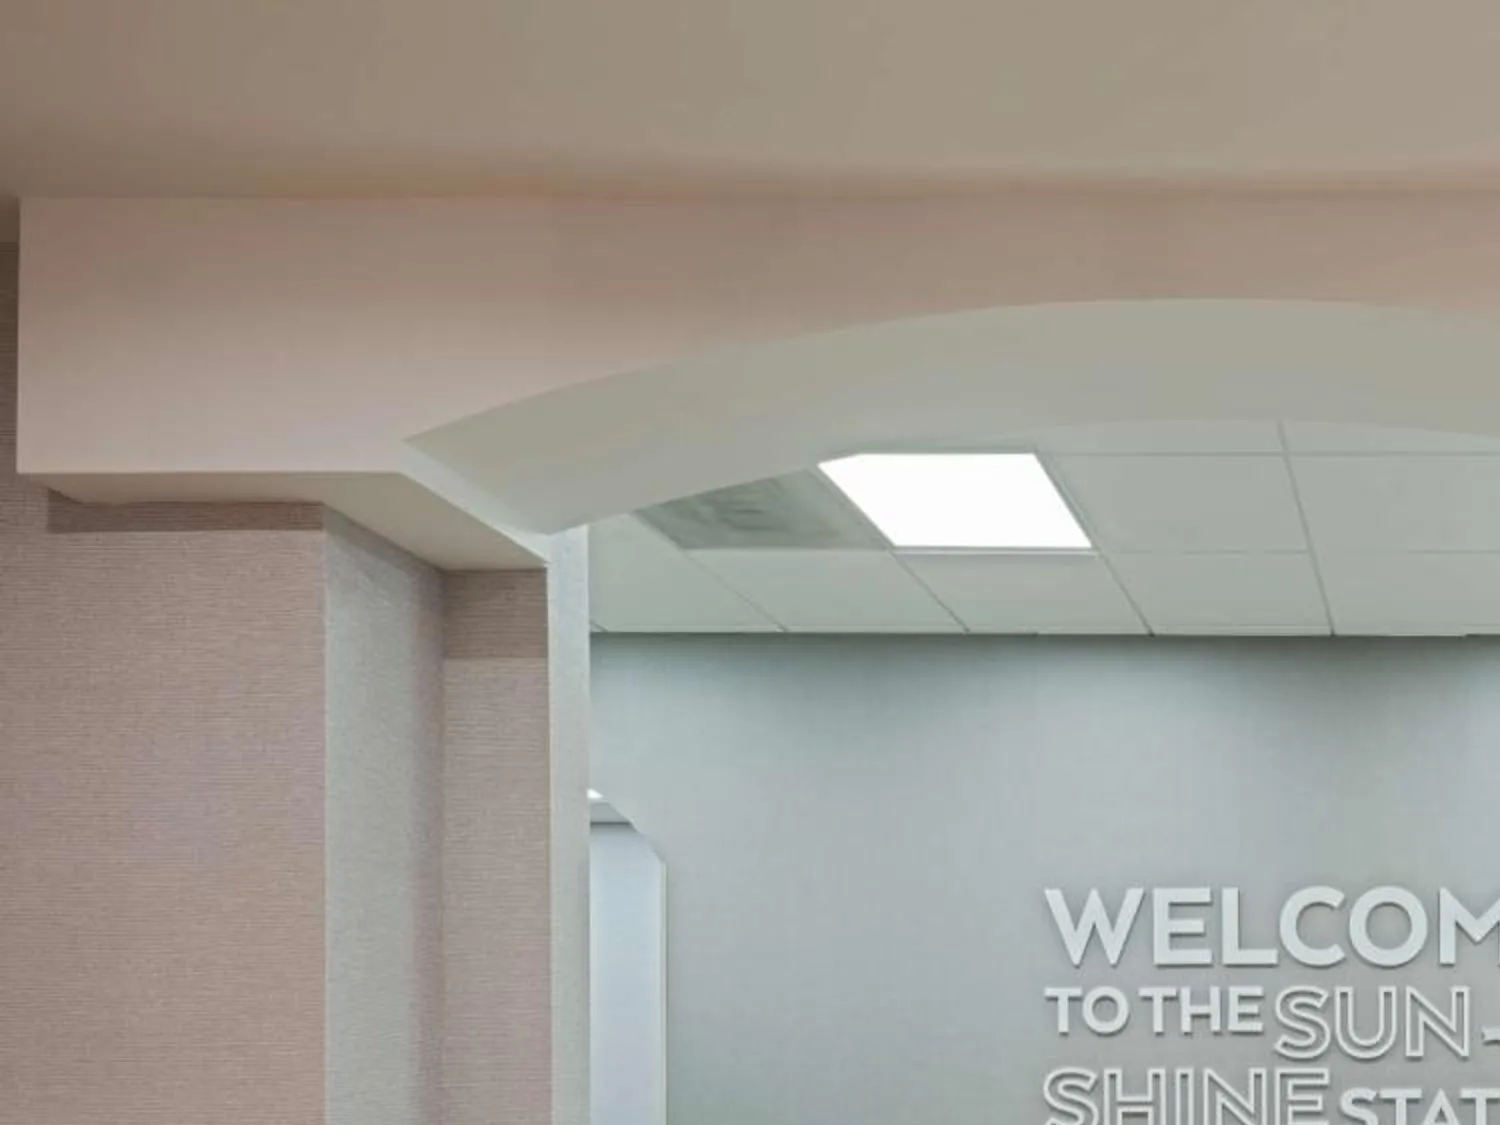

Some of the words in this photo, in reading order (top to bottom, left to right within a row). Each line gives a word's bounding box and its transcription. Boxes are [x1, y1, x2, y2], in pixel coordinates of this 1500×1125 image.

[1044, 987, 1129, 1035] TO
[1138, 986, 1264, 1033] THE
[1274, 985, 1470, 1059] SUN
